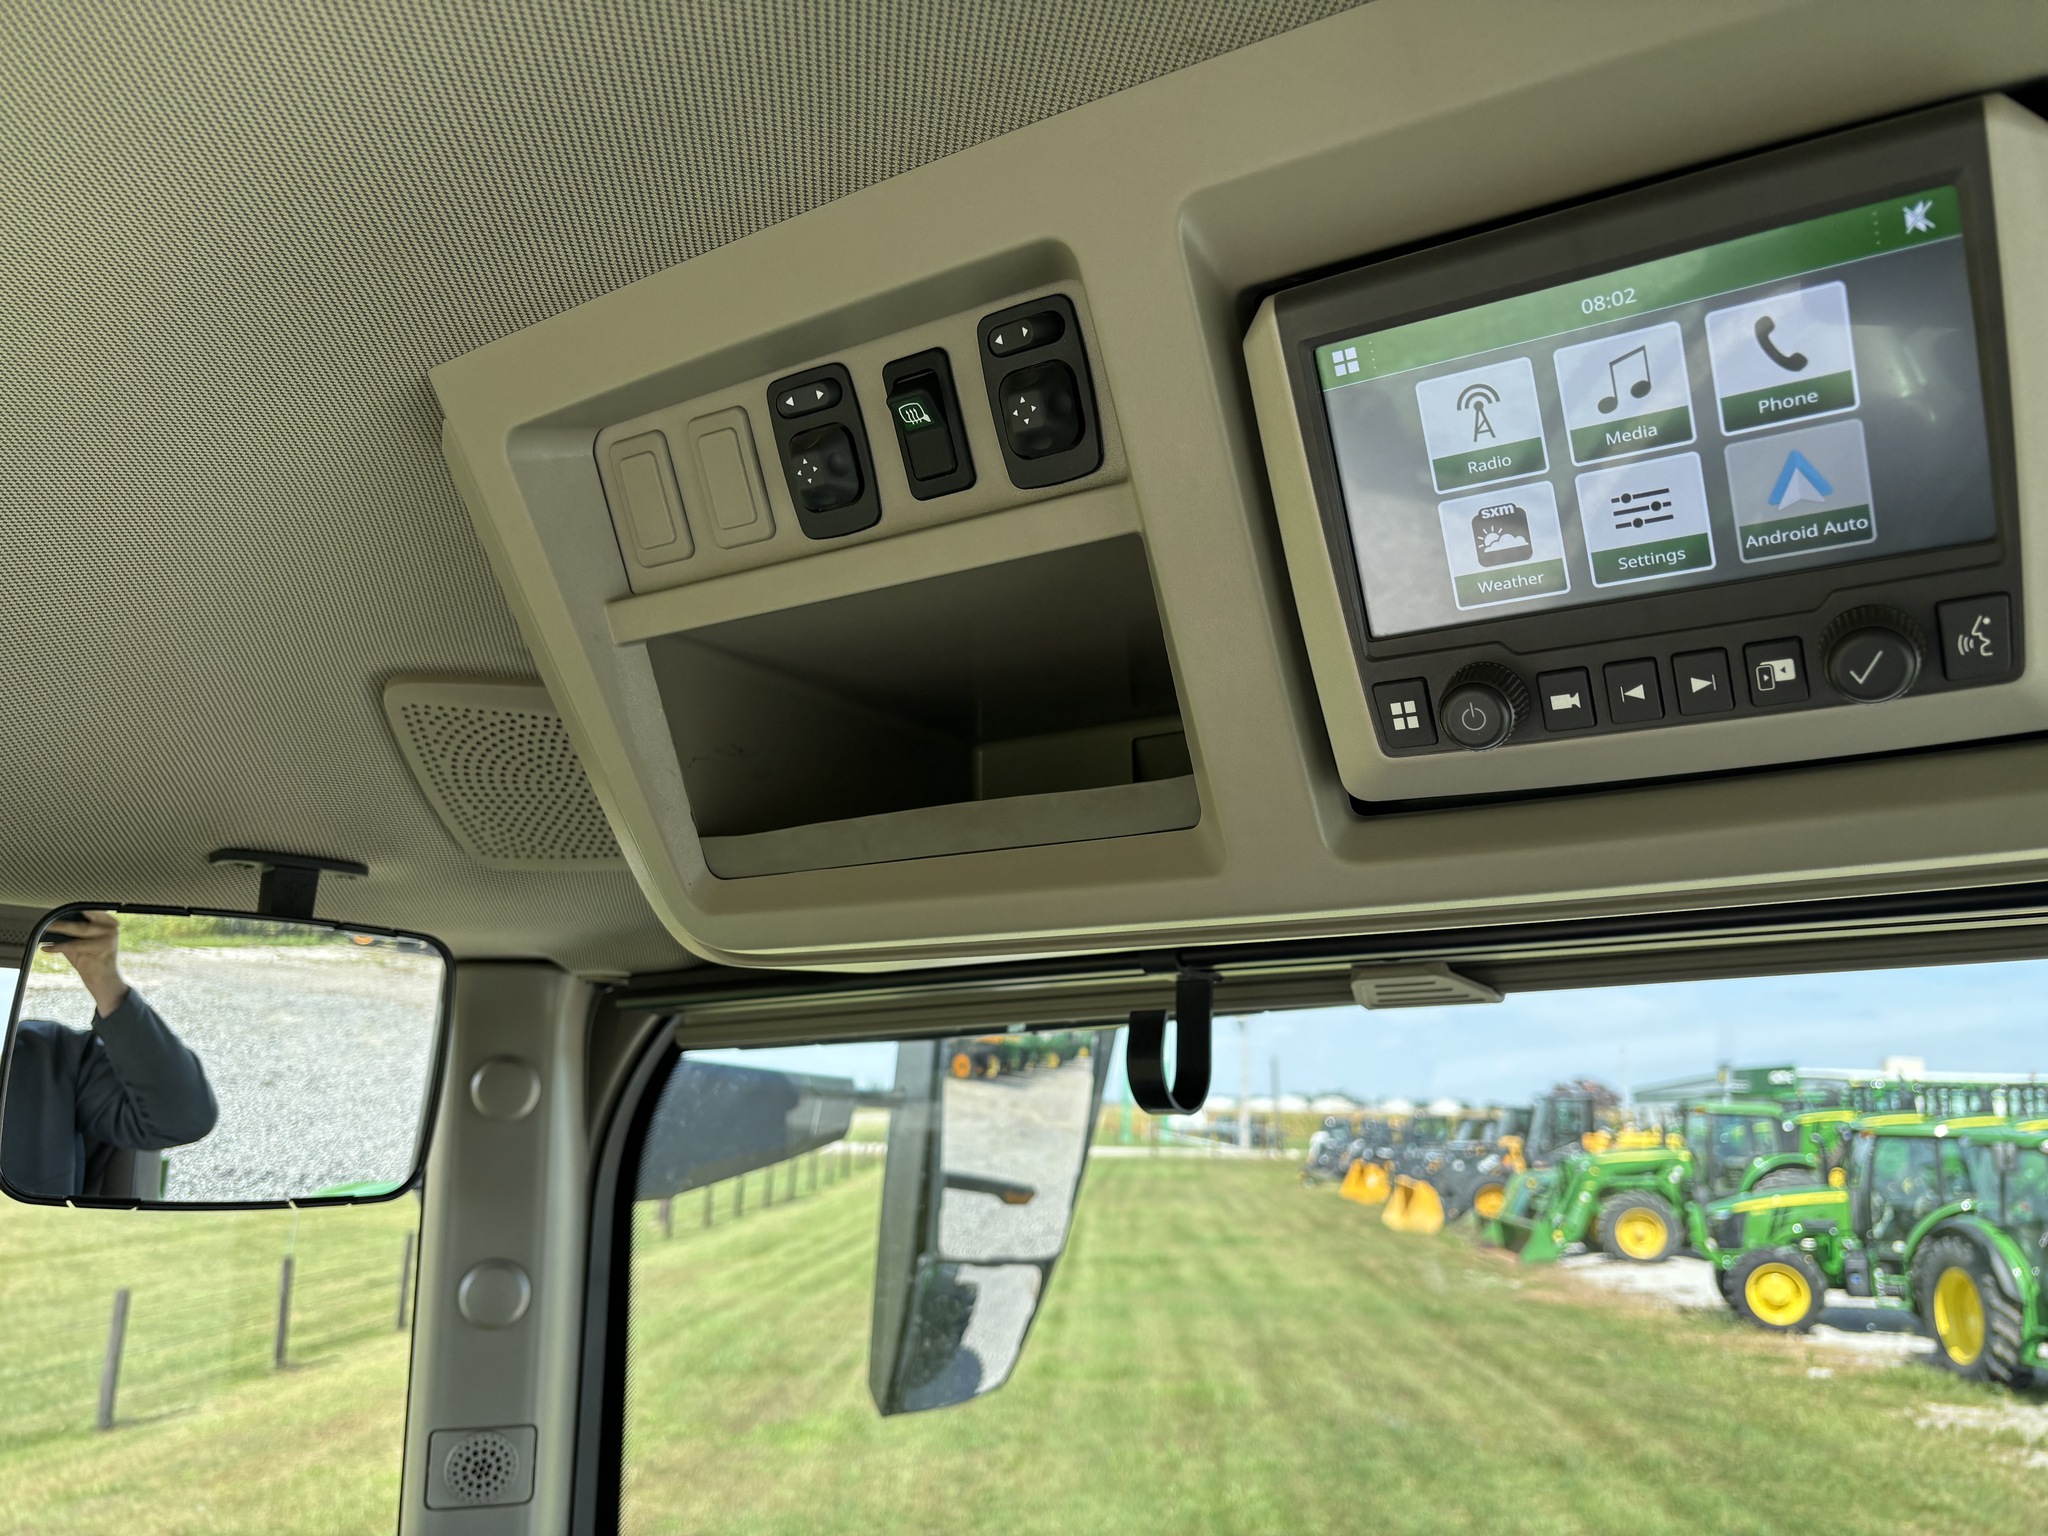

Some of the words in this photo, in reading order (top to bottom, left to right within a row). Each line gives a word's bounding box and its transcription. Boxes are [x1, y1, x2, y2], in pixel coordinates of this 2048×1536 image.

[1580, 288, 1637, 315] 08:02
[1757, 389, 1819, 414] Phone
[1605, 424, 1658, 447] Media
[1467, 453, 1513, 475] Radio
[1480, 502, 1515, 520] sxm
[1745, 523, 1818, 549] Android
[1823, 516, 1869, 536] Auto
[1617, 547, 1687, 571] Settings
[1477, 570, 1545, 594] Weather
